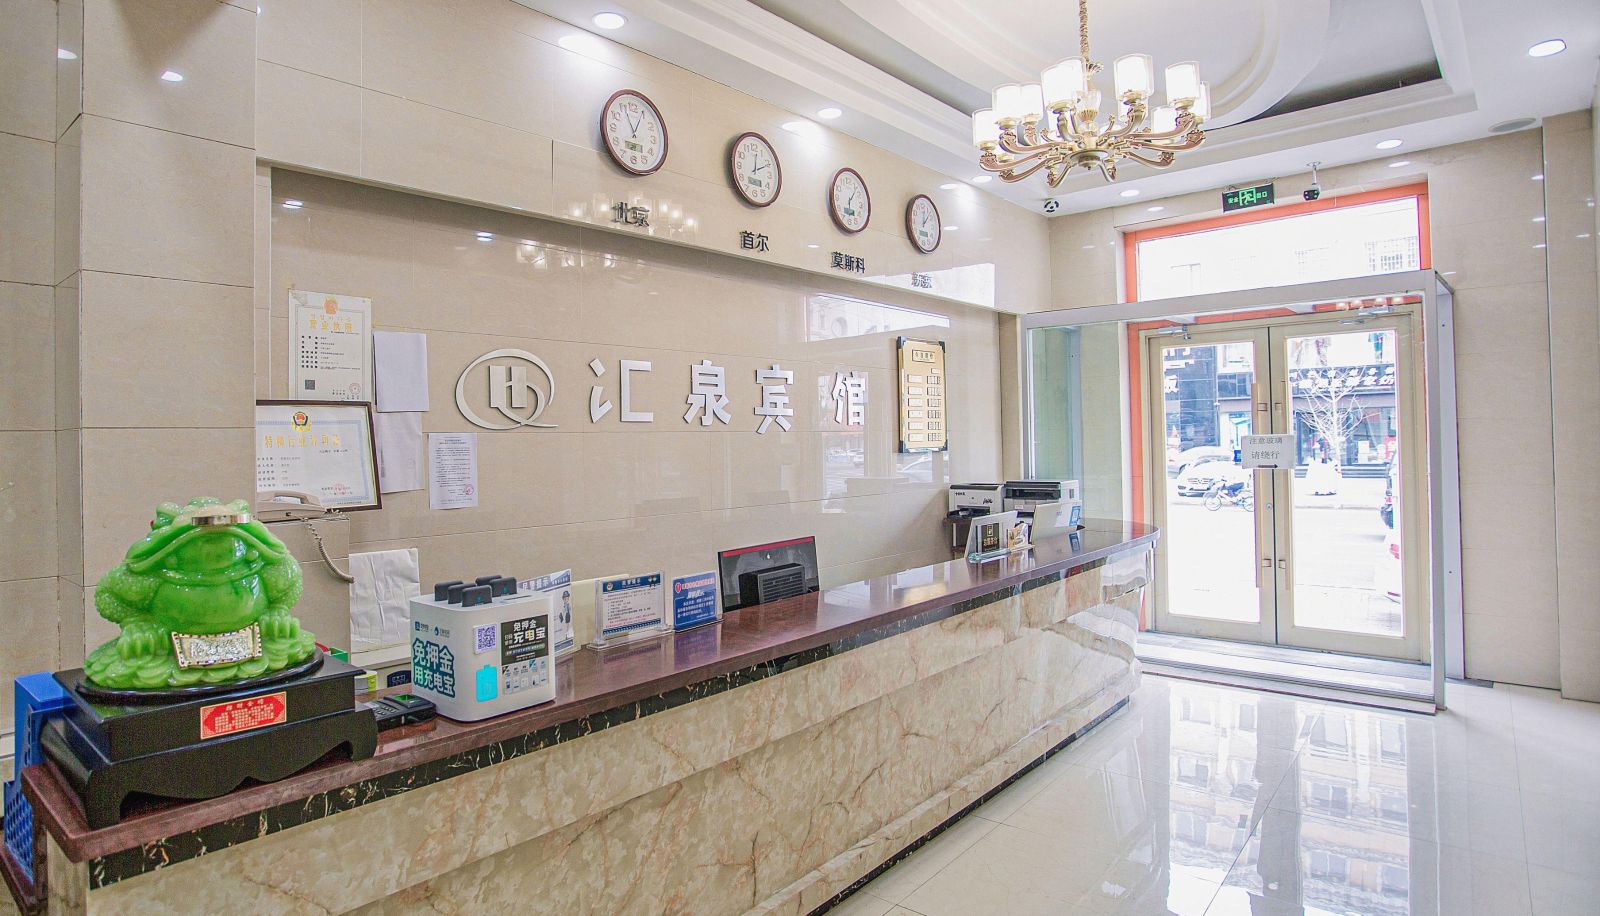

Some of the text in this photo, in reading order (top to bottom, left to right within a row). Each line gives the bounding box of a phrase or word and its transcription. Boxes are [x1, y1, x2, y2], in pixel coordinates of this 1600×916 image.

[611, 201, 650, 227] 北京
[739, 230, 770, 252] 首尔
[831, 251, 865, 273] 莫斯科
[589, 358, 869, 434] 汇泉宾馆
[1251, 451, 1280, 459] 请绕行
[514, 619, 537, 632] 免押金
[514, 627, 546, 644] 充电宝
[413, 639, 454, 675] 免押金
[414, 665, 455, 696] 用充电宝
